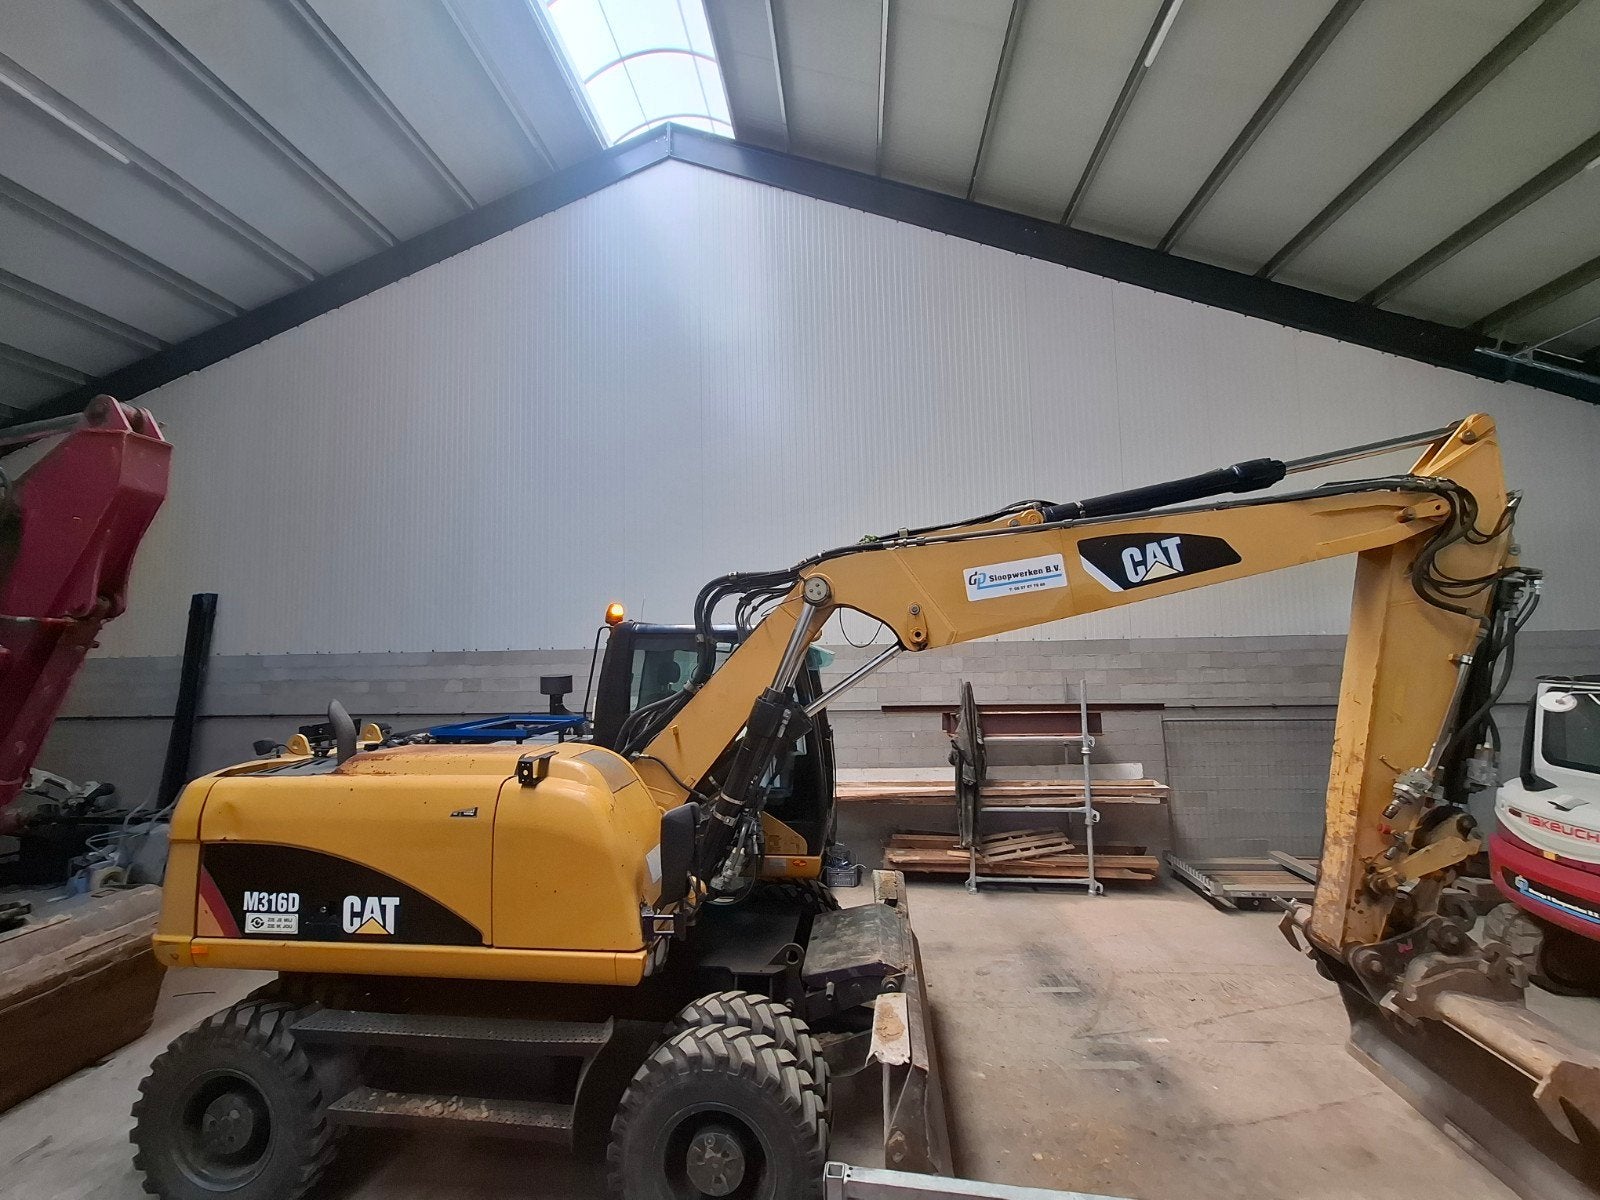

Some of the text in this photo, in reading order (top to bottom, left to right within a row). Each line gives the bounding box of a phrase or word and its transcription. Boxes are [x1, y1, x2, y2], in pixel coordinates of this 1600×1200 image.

[1121, 536, 1184, 583] CAT
[988, 567, 1044, 583] Sloopwerken
[243, 891, 300, 912] M316D
[342, 895, 400, 935] CAT
